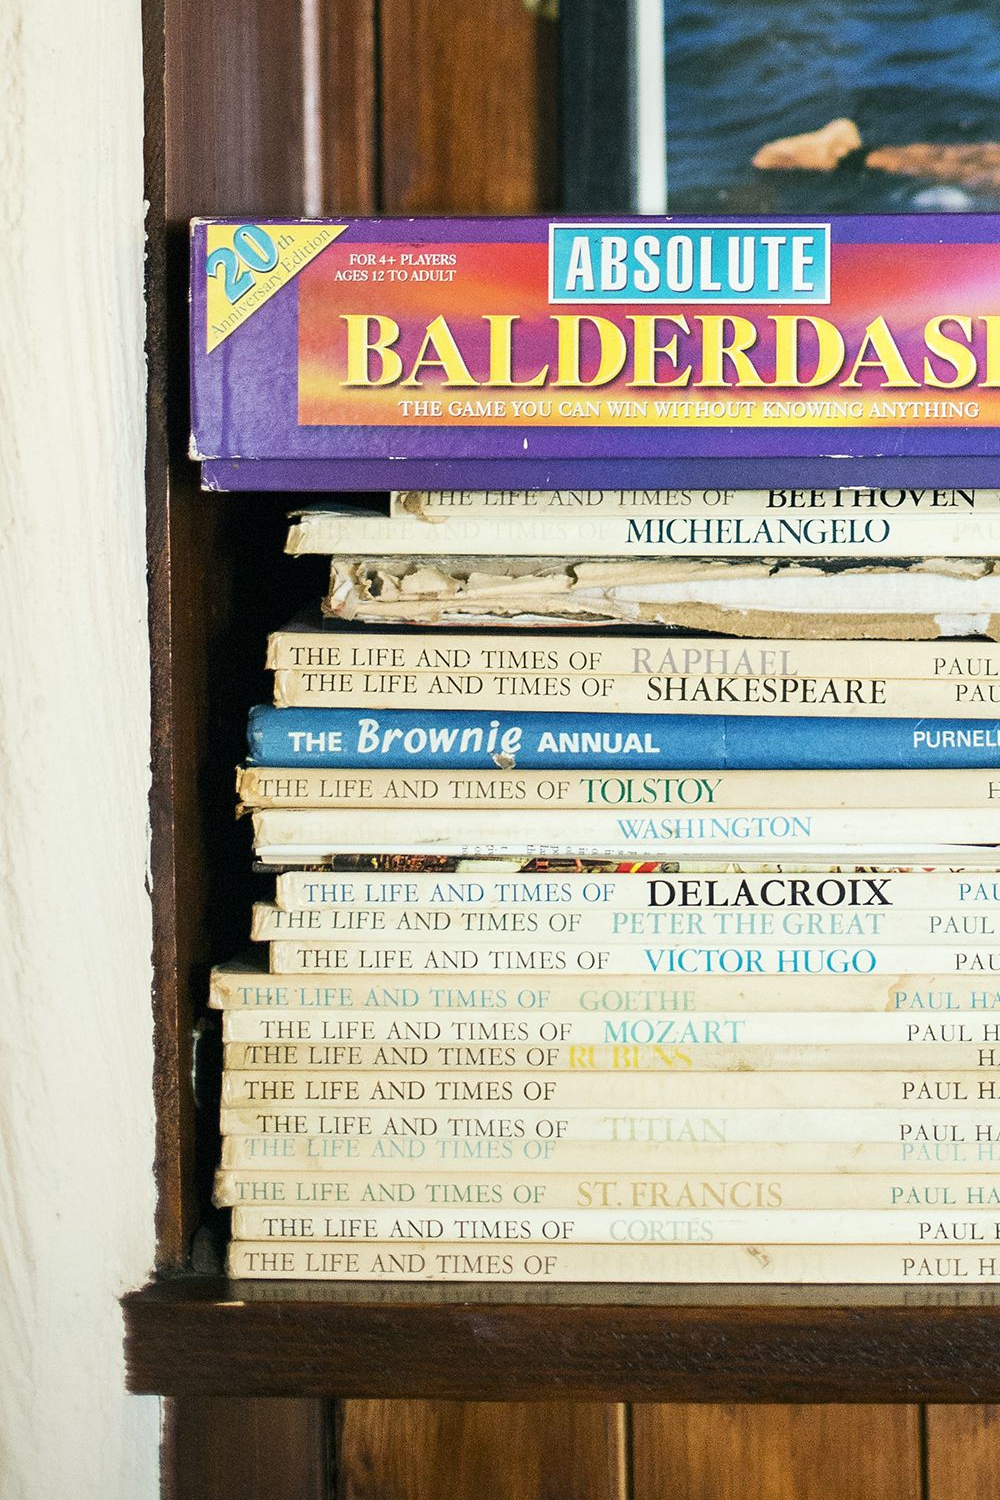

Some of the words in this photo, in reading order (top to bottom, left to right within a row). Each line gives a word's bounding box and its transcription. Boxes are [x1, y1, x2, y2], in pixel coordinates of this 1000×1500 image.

[350, 255, 376, 266] FOR
[379, 255, 396, 266] 4+
[400, 254, 457, 266] PLAYERS
[564, 235, 814, 292] ABSOLUTE
[211, 272, 284, 338] Anniversary
[281, 229, 331, 274] Edition
[334, 270, 369, 282] AGES
[372, 270, 385, 282] 12
[388, 270, 408, 282] TO
[411, 270, 457, 282] ADULT
[398, 402, 442, 417] THE
[448, 402, 506, 417] GAME
[512, 402, 552, 417] YOU
[558, 402, 600, 418] CAN
[608, 402, 648, 418] WIN
[654, 402, 757, 418] WITHOUT
[763, 402, 862, 418] KNOWING
[869, 402, 979, 418] ANYTHING
[766, 489, 977, 510] BEETHOVEN
[625, 518, 890, 544] MICHELANGELO
[290, 647, 340, 666] THE
[351, 648, 405, 667] LIFE
[417, 649, 471, 668] AND
[481, 650, 558, 670] TIMES
[569, 651, 602, 671] OF
[632, 647, 798, 676] RAPHAEL
[933, 657, 999, 675] PAUL
[302, 673, 352, 692] THE
[363, 674, 417, 693] LIFE
[429, 676, 482, 695] AND
[494, 677, 570, 696] TIMES
[581, 678, 615, 697] OF
[647, 677, 887, 704] SHAKESPEARE
[288, 732, 342, 752] THE
[358, 718, 522, 753] Brownie
[537, 732, 660, 753] ANNUAL
[258, 779, 309, 798] THE
[320, 779, 373, 799] LIFE
[384, 780, 439, 799] AND
[448, 781, 526, 799] TIMES
[537, 781, 570, 799] OF
[580, 778, 723, 804] TOLSTOY
[617, 816, 813, 839] WASHINGTON
[304, 883, 354, 901] THE
[366, 884, 419, 902] LIFE
[430, 884, 484, 902] AND
[495, 884, 572, 902] TIMES
[583, 883, 615, 902] OF
[647, 879, 893, 907] DELACROIX
[272, 911, 321, 929] THE
[332, 911, 386, 930] LIFE
[397, 912, 451, 931] AND
[461, 912, 538, 932] TIMES
[549, 913, 582, 932] OF
[611, 912, 705, 935] PETER
[714, 912, 774, 935] THE
[783, 912, 885, 935] GREAT
[929, 916, 994, 934] PAUL
[296, 949, 348, 968] THE
[359, 950, 413, 969] LIFE
[424, 950, 478, 969] AND
[489, 951, 566, 970] TIMES
[577, 951, 610, 970] OF
[644, 948, 764, 973] VICTOR
[778, 948, 876, 973] HUGO
[238, 987, 289, 1005] THE
[300, 988, 353, 1007] LIFE
[364, 988, 419, 1007] AND
[430, 989, 507, 1008] TIMES
[518, 990, 550, 1008] OF
[579, 990, 696, 1012] GOETHE
[894, 992, 960, 1009] PAUL
[260, 1020, 312, 1039] THE
[321, 1021, 375, 1040] LIFE
[387, 1021, 441, 1040] AND
[451, 1022, 529, 1041] TIMES
[540, 1022, 572, 1041] OF
[604, 1020, 745, 1043] MOZART
[907, 1024, 972, 1042] PAUL
[247, 1046, 297, 1064] THE
[309, 1046, 362, 1065] LIFE
[374, 1046, 427, 1066] AND
[438, 1047, 516, 1066] TIMES
[527, 1047, 559, 1066] OF
[244, 1081, 295, 1100] THE
[305, 1081, 359, 1100] LIFE
[370, 1081, 425, 1100] AND
[435, 1081, 513, 1100] TIMES
[524, 1081, 556, 1100] OF
[902, 1082, 968, 1100] PAUL
[257, 1115, 307, 1133] THE
[318, 1116, 372, 1134] LIFE
[383, 1117, 437, 1136] AND
[448, 1119, 524, 1137] TIMES
[536, 1120, 568, 1138] OF
[603, 1117, 728, 1142] TITIAN
[900, 1124, 964, 1141] PAUL
[245, 1139, 294, 1157] THE
[307, 1139, 359, 1157] LIFE
[370, 1139, 425, 1157] AND
[435, 1140, 513, 1159] TIMES
[524, 1140, 557, 1159] OF
[902, 1144, 967, 1161] PAUL
[235, 1182, 285, 1200] THE
[296, 1182, 349, 1201] LIFE
[360, 1183, 415, 1202] AND
[425, 1184, 502, 1203] TIMES
[514, 1185, 545, 1204] OF
[577, 1182, 622, 1208] ST.
[630, 1182, 782, 1208] FRANCIS
[890, 1187, 956, 1204] PAUL
[263, 1218, 314, 1237] THE
[324, 1218, 378, 1238] LIFE
[389, 1219, 443, 1238] AND
[454, 1220, 531, 1239] TIMES
[542, 1220, 574, 1239] OF
[610, 1217, 713, 1241] CORTÉS
[919, 1222, 984, 1240] PAUL
[244, 1252, 295, 1271] THE
[305, 1253, 359, 1272] LIFE
[370, 1254, 425, 1273] AND
[435, 1255, 513, 1274] TIMES
[524, 1255, 557, 1274] OF
[902, 1258, 968, 1276] PAUL
